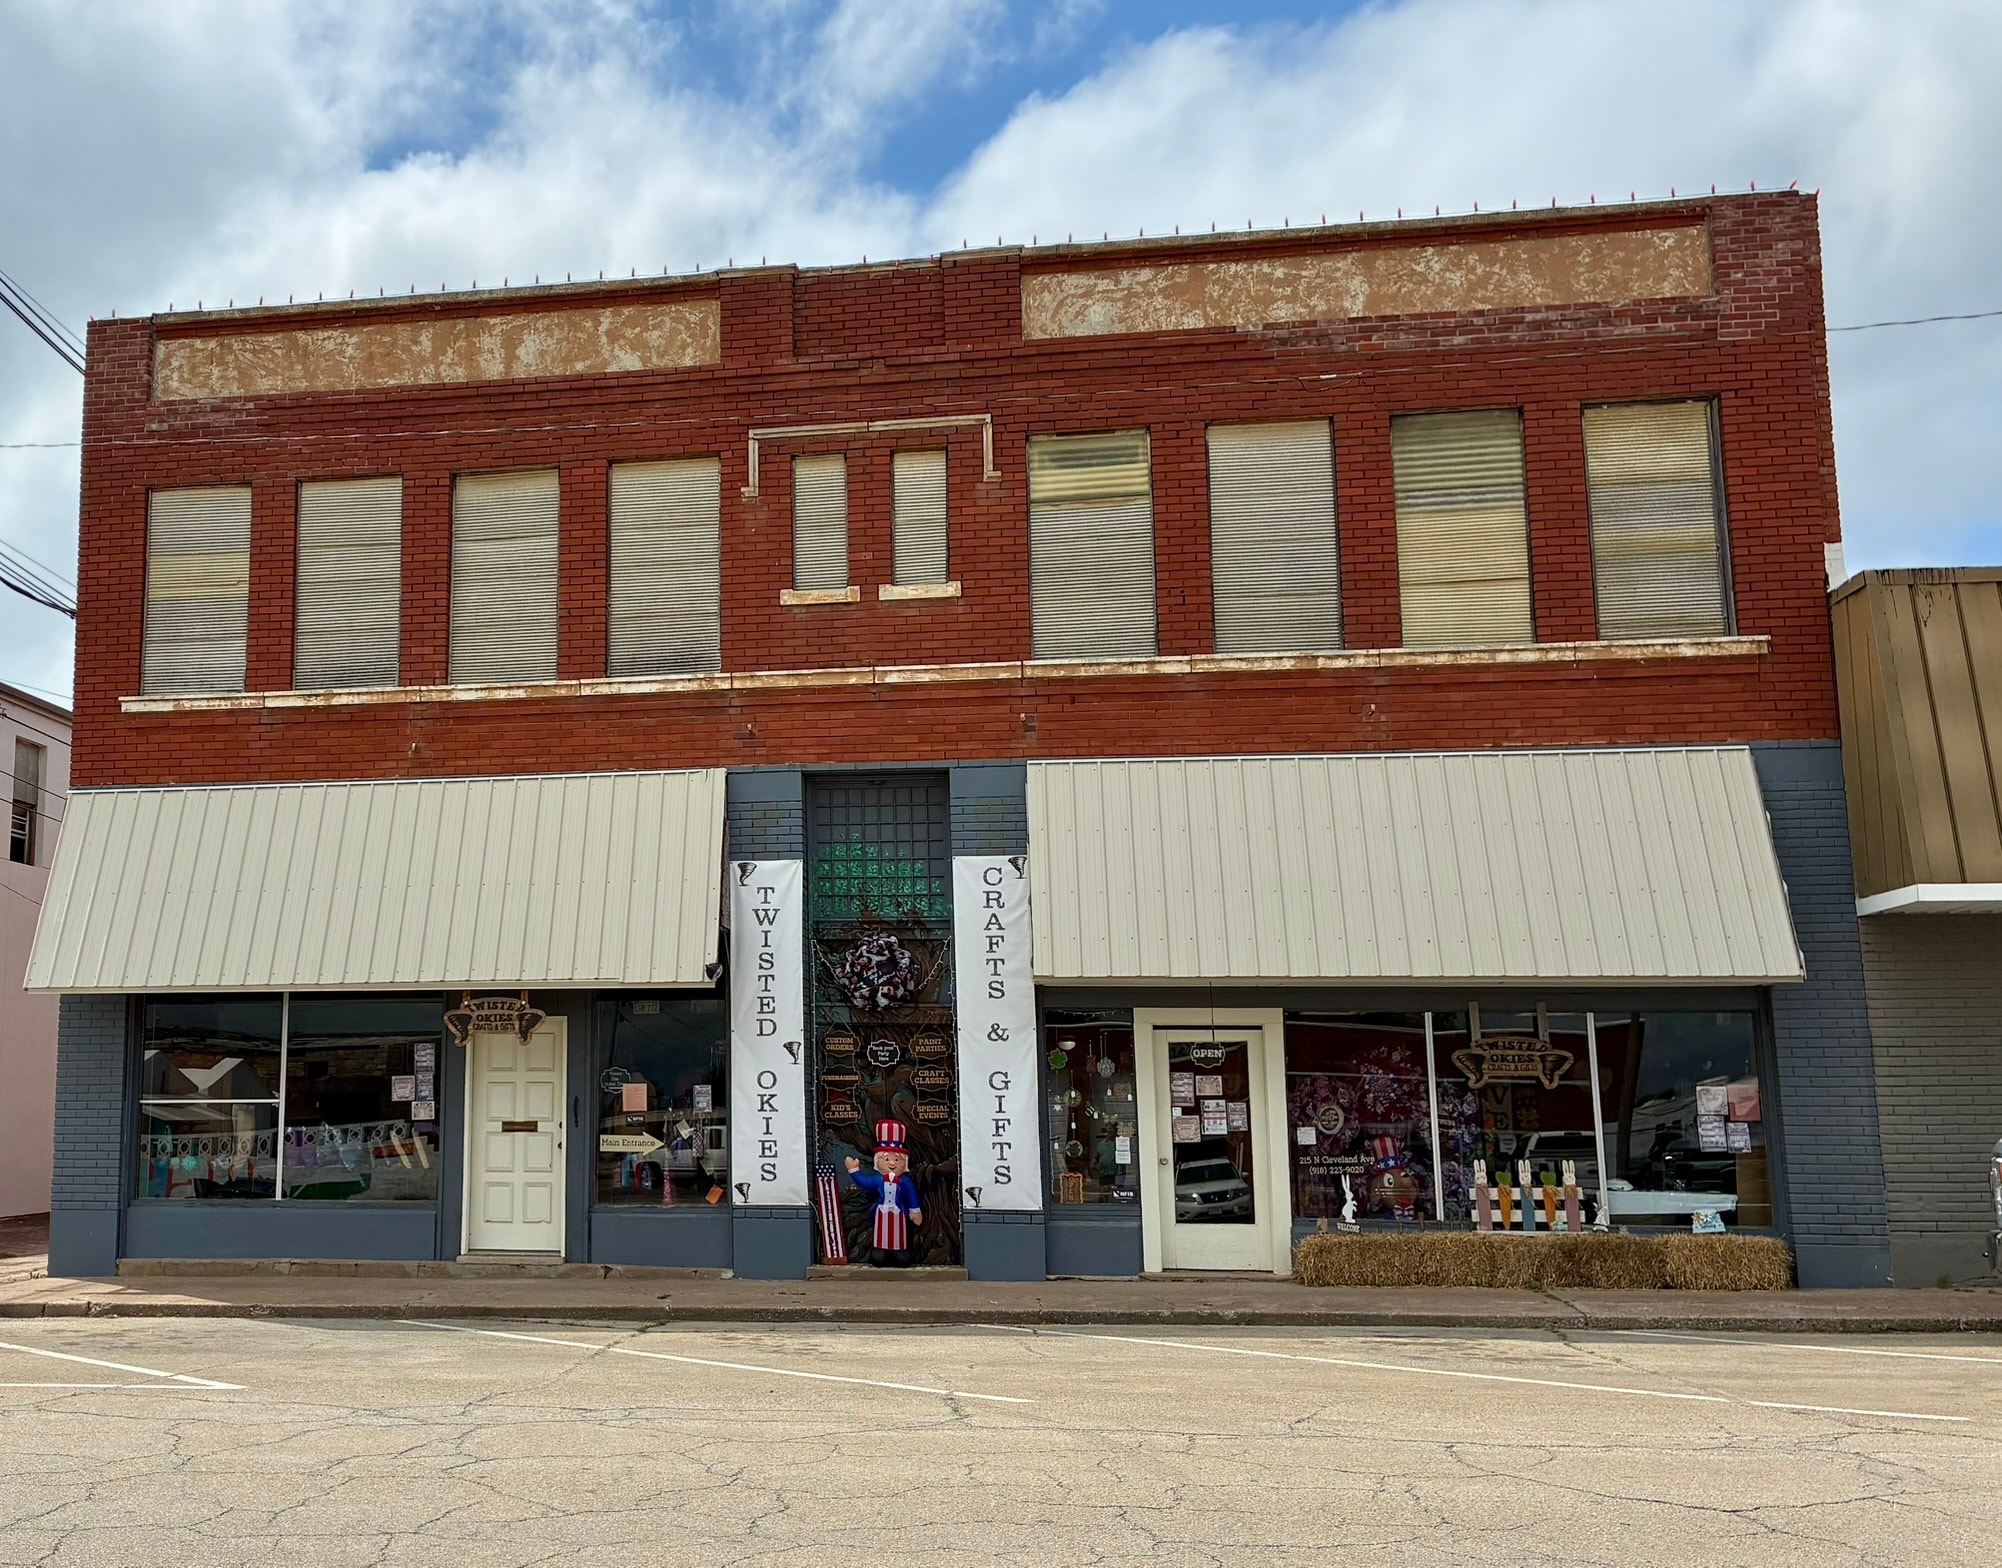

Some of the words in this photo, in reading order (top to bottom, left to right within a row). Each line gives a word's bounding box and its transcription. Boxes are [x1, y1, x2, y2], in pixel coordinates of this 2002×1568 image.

[982, 866, 1006, 1000] CRAFTS
[752, 886, 780, 1037] TWISTED
[464, 1001, 527, 1013] TWISTED
[476, 1013, 514, 1022] OKIES
[986, 1022, 1010, 1042] &
[1475, 1040, 1548, 1052] TWISTED
[1192, 1049, 1223, 1058] OPEN
[1490, 1054, 1534, 1063] OKIES
[824, 1111, 858, 1119] CLASSES
[756, 1070, 779, 1182] OKIES
[988, 1070, 1012, 1185] GIFTS
[602, 1138, 620, 1147] Main
[622, 1138, 656, 1147] Entrance
[1298, 1156, 1312, 1165] 215
[1314, 1156, 1320, 1164] N
[1321, 1155, 1358, 1164] Cleveland
[1309, 1166, 1328, 1175] (918)
[1329, 1166, 1365, 1174] 223-9020
[1336, 1222, 1361, 1233] WELCOME
